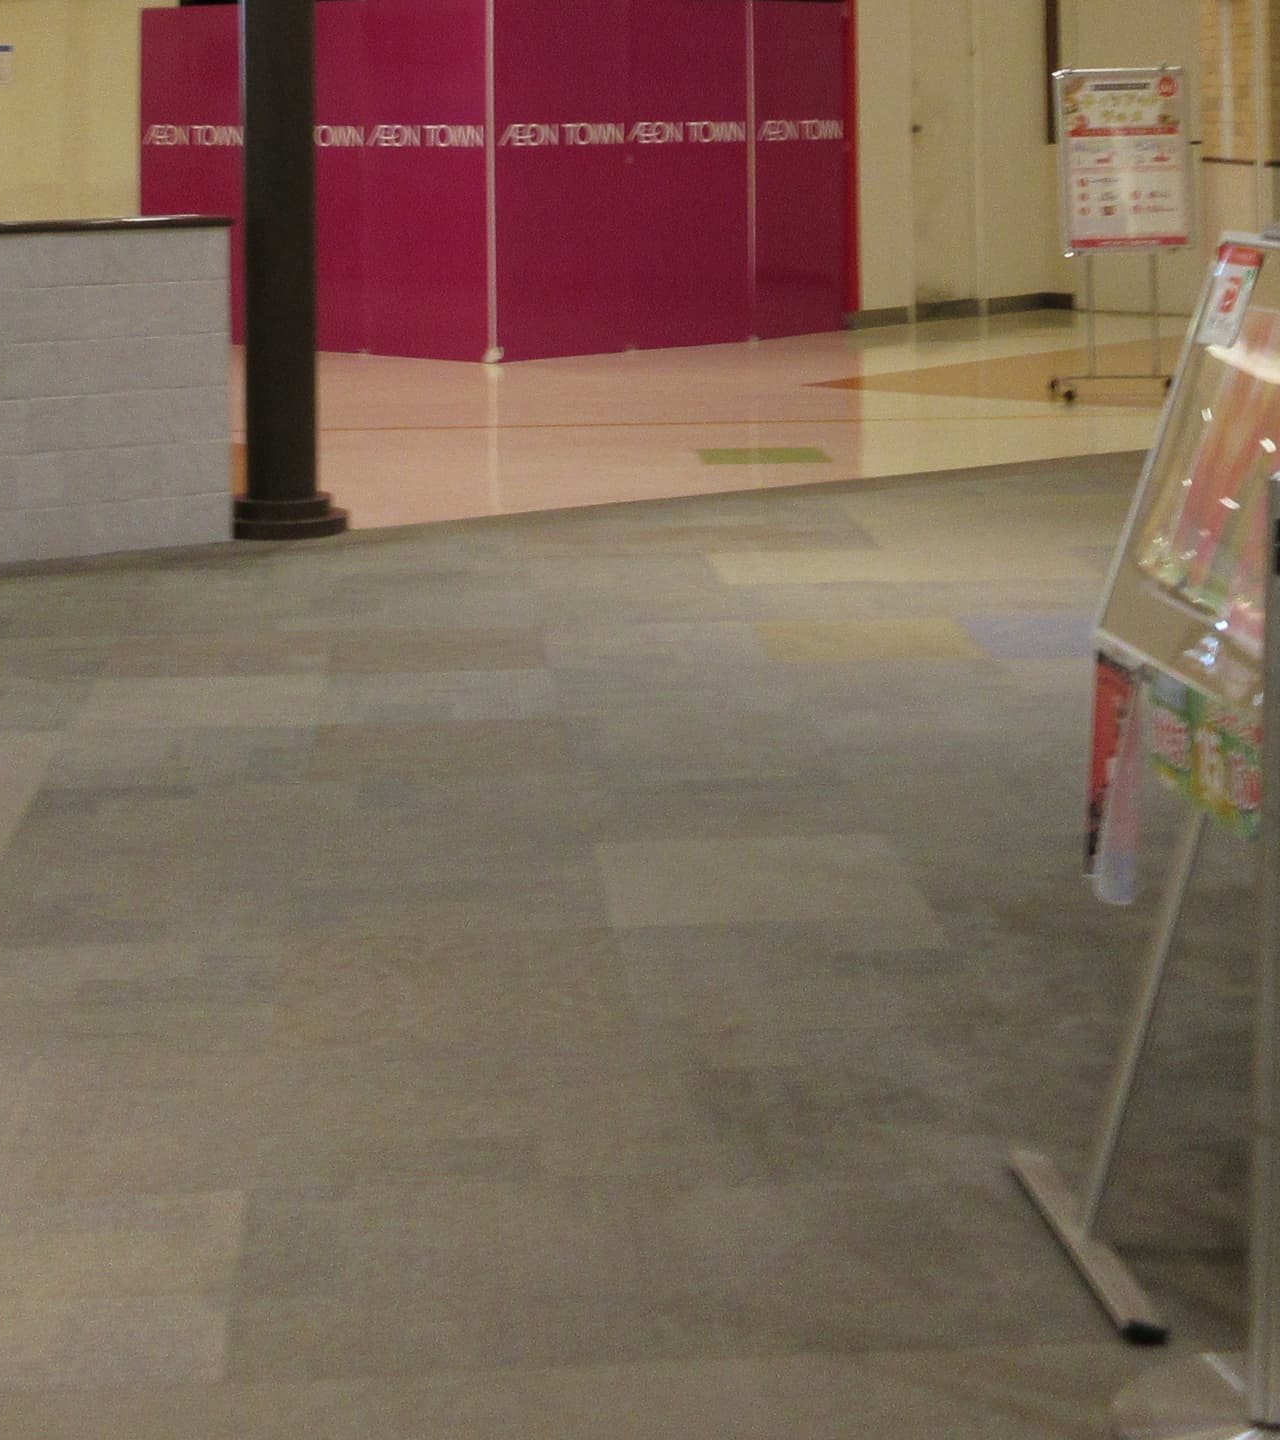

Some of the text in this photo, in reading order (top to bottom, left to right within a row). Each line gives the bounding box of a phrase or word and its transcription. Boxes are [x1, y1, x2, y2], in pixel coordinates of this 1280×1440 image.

[312, 124, 365, 147] OWN
[422, 124, 484, 147] TOWN
[561, 122, 625, 146] TOWN
[685, 120, 746, 143] TOWN
[799, 119, 845, 141] TOWN
